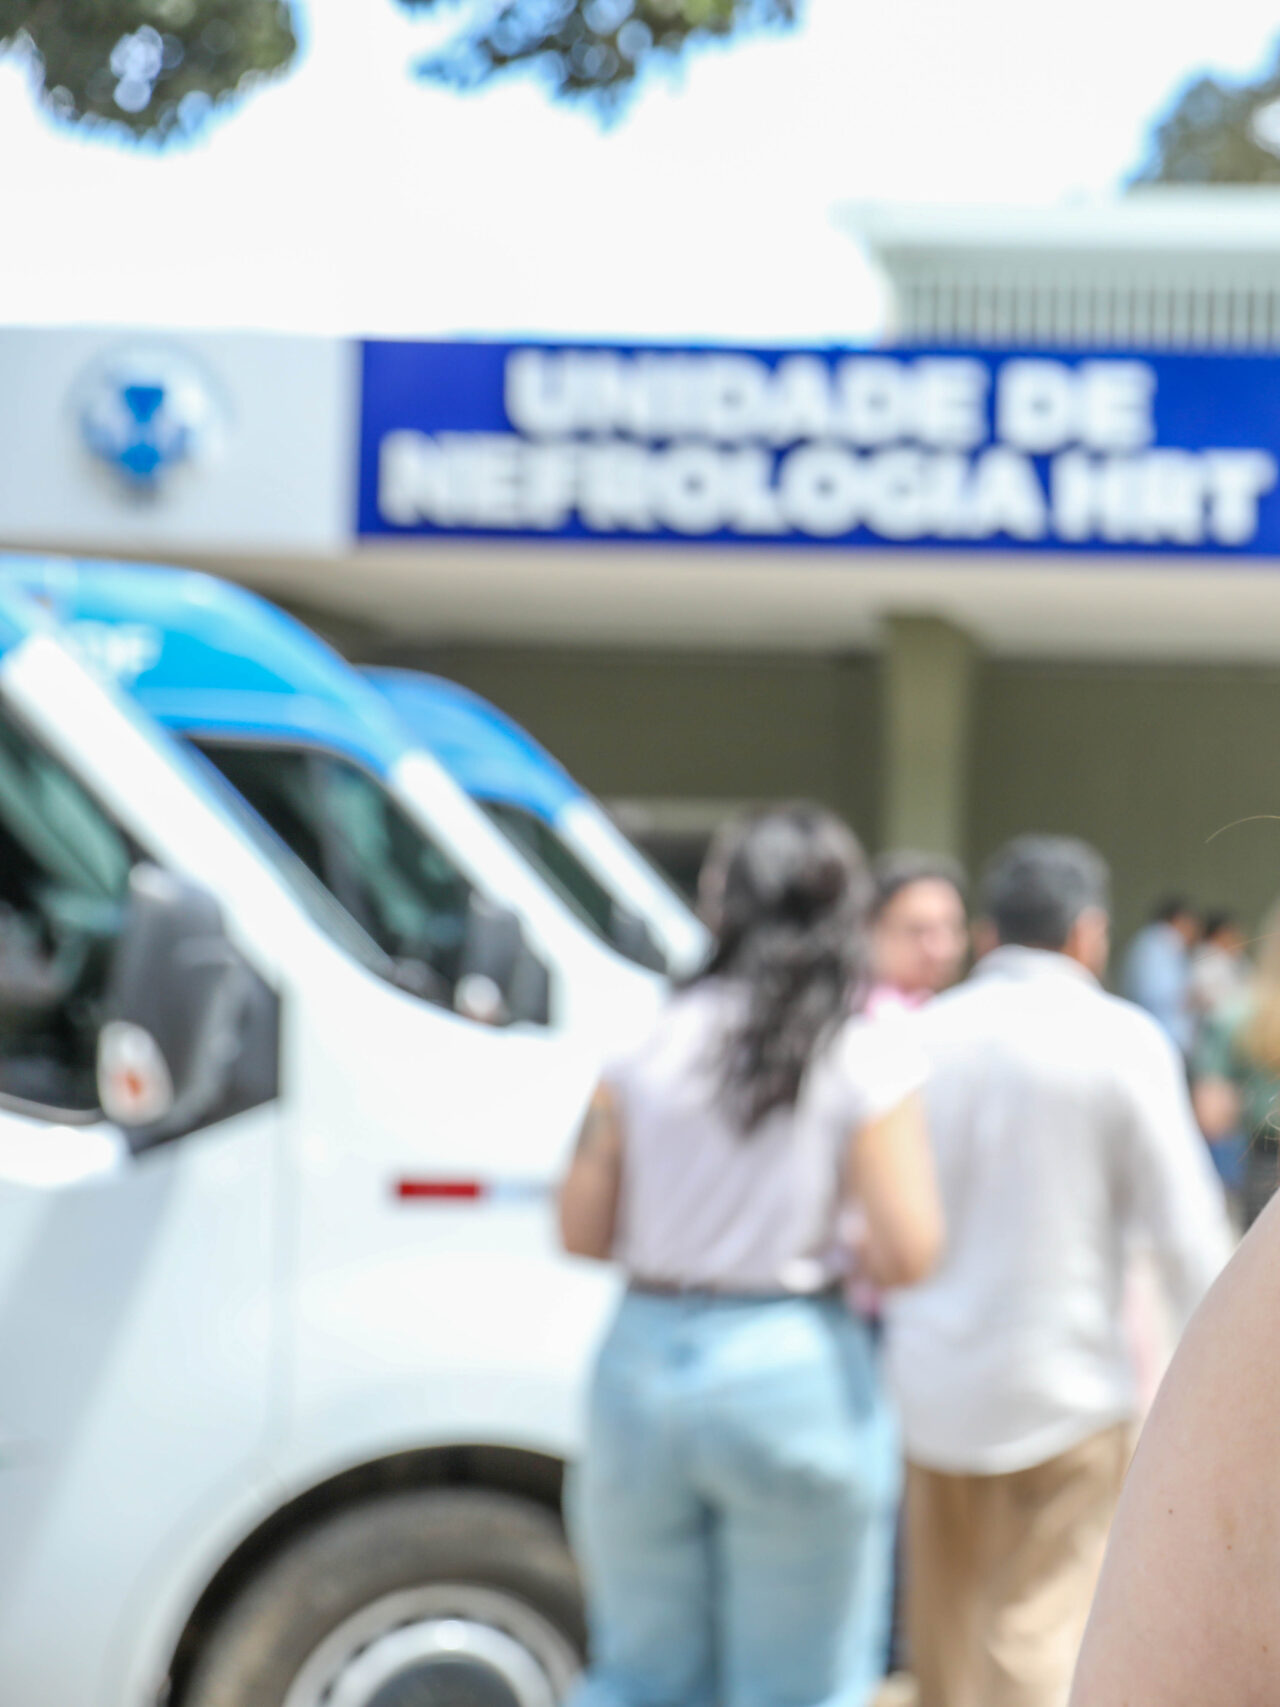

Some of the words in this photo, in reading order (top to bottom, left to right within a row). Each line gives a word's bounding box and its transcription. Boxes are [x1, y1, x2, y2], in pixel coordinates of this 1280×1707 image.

[507, 352, 989, 450] UNIDADE
[1000, 359, 1154, 454] DE
[381, 430, 1046, 541] NEFROLOGIA
[1051, 445, 1275, 545] HRT
